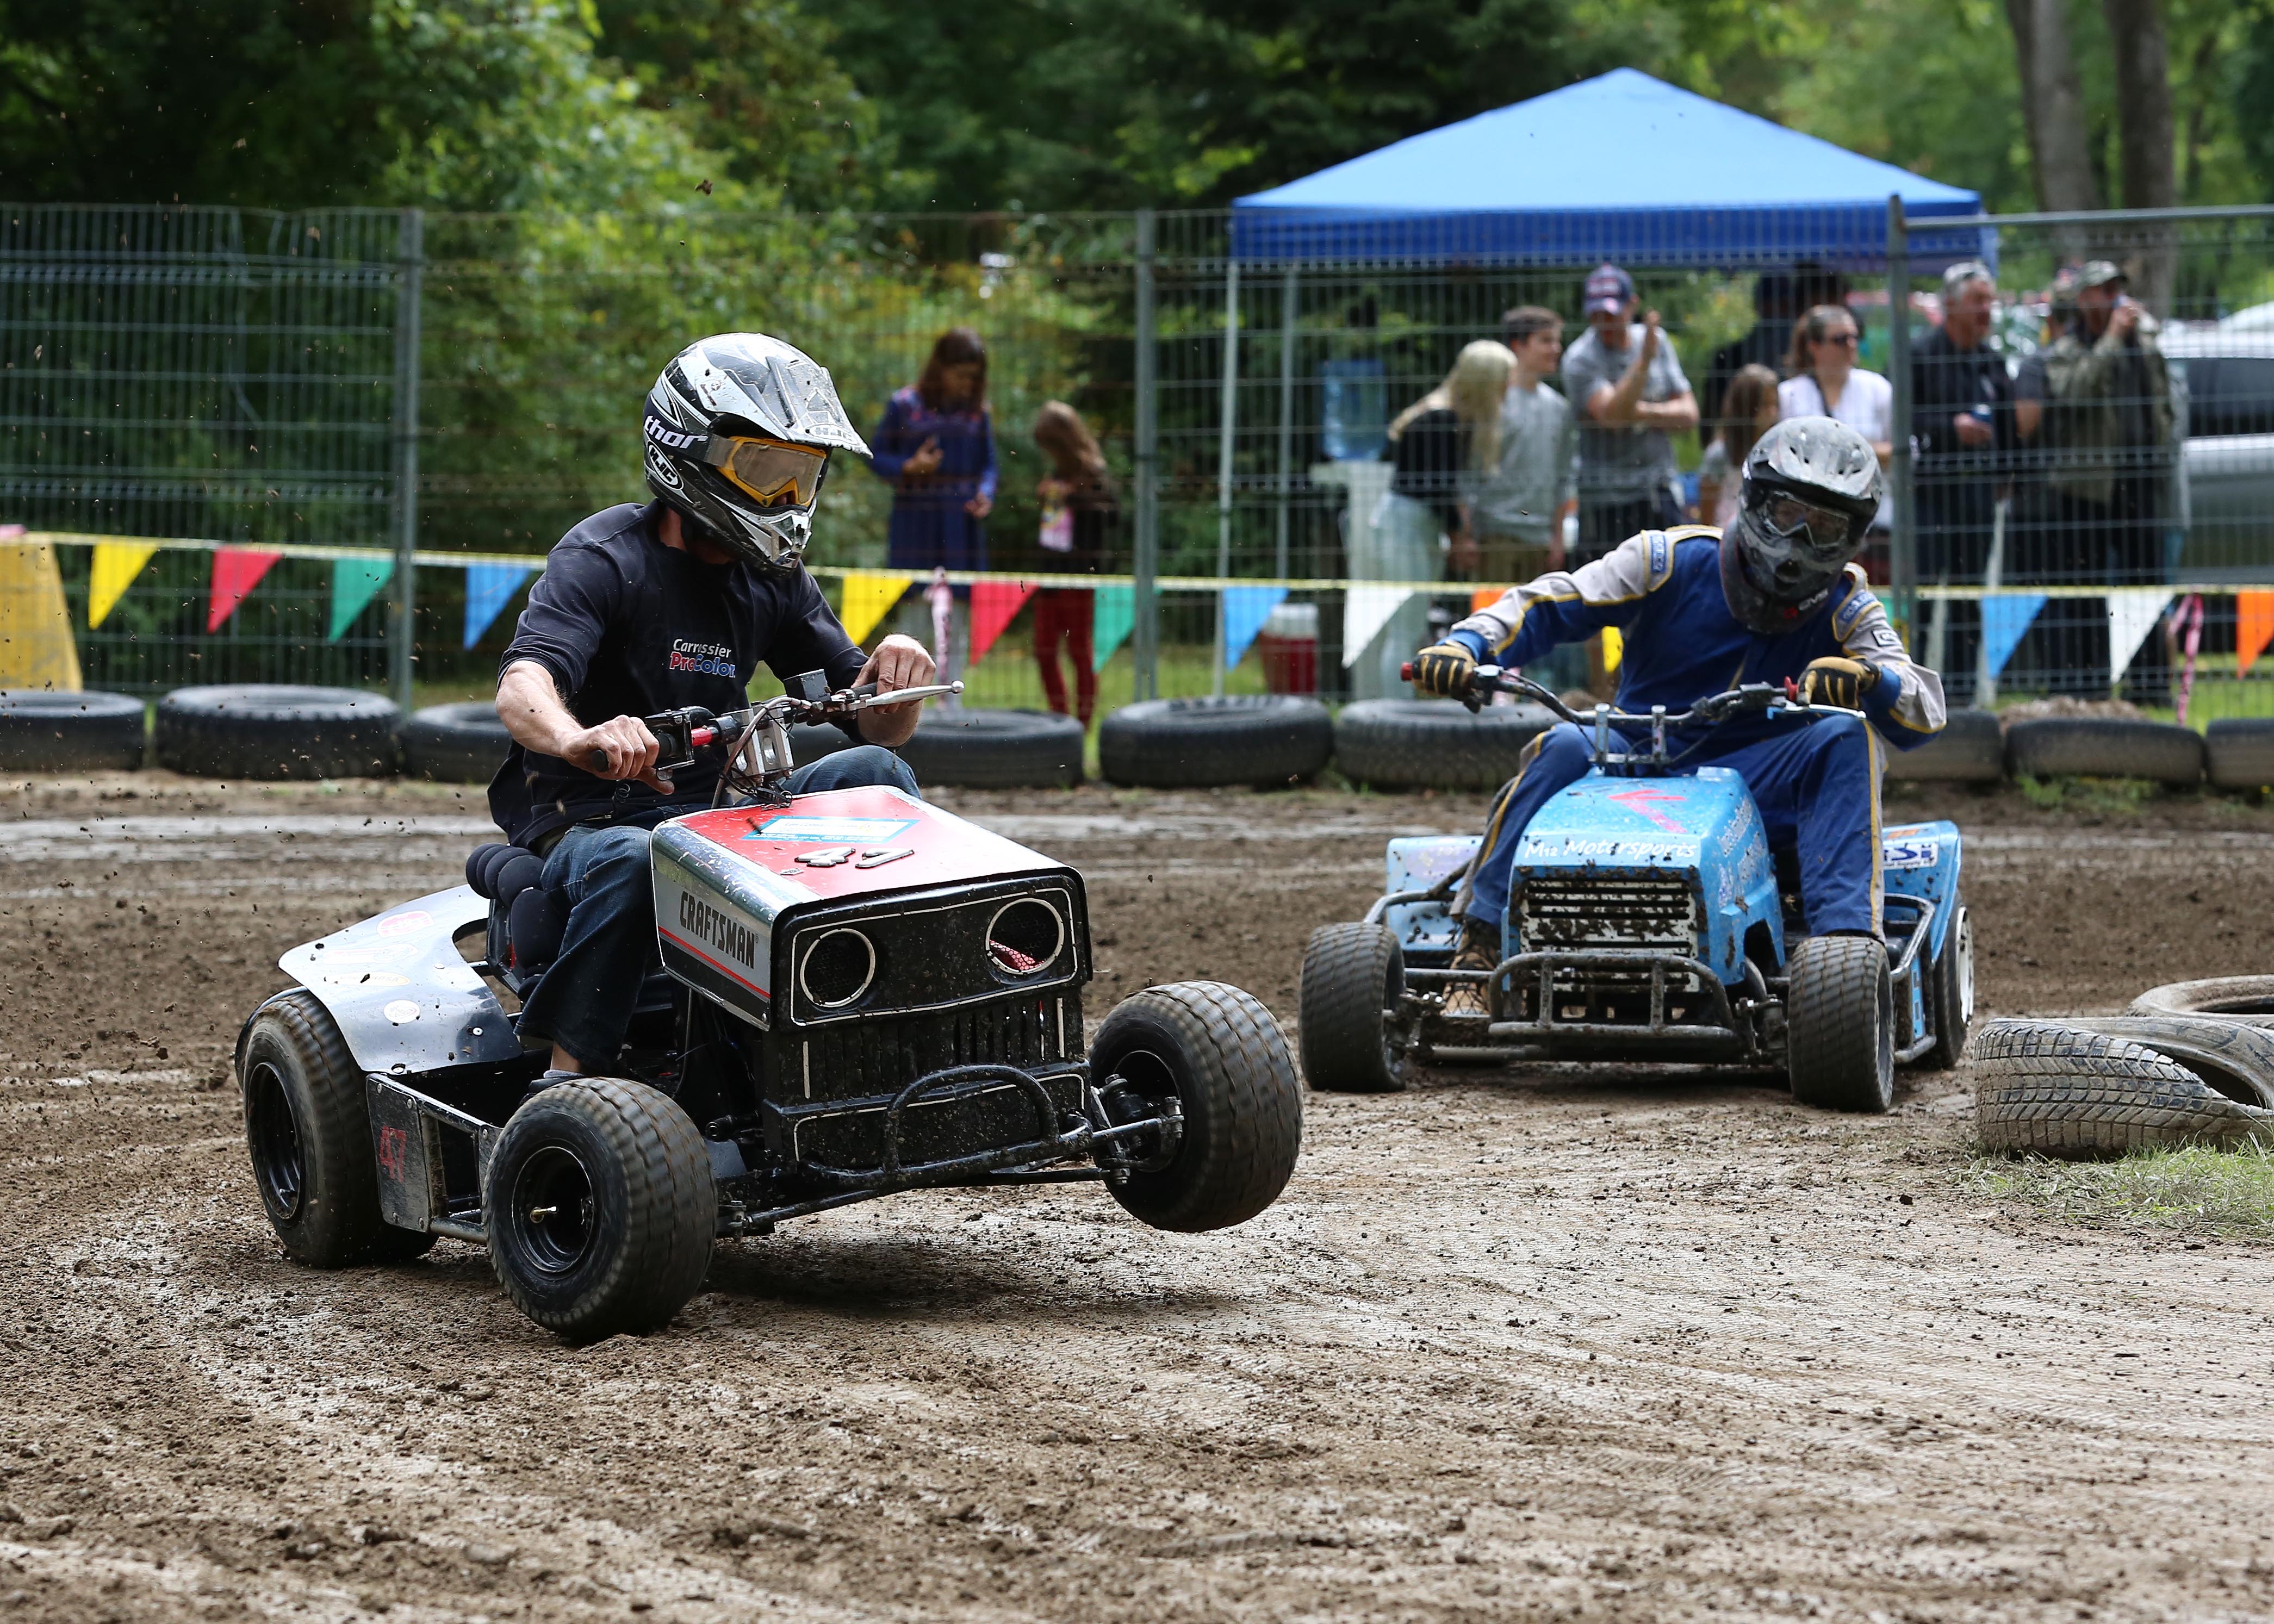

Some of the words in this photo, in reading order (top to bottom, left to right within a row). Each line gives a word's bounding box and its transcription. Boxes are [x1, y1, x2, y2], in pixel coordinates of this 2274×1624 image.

[644, 415, 709, 449] thor
[649, 447, 678, 482] HJC
[794, 847, 915, 869] 47
[1563, 839, 1697, 860] Motorsports
[680, 891, 754, 969] CRAFTSMAN
[380, 1125, 406, 1183] 47
